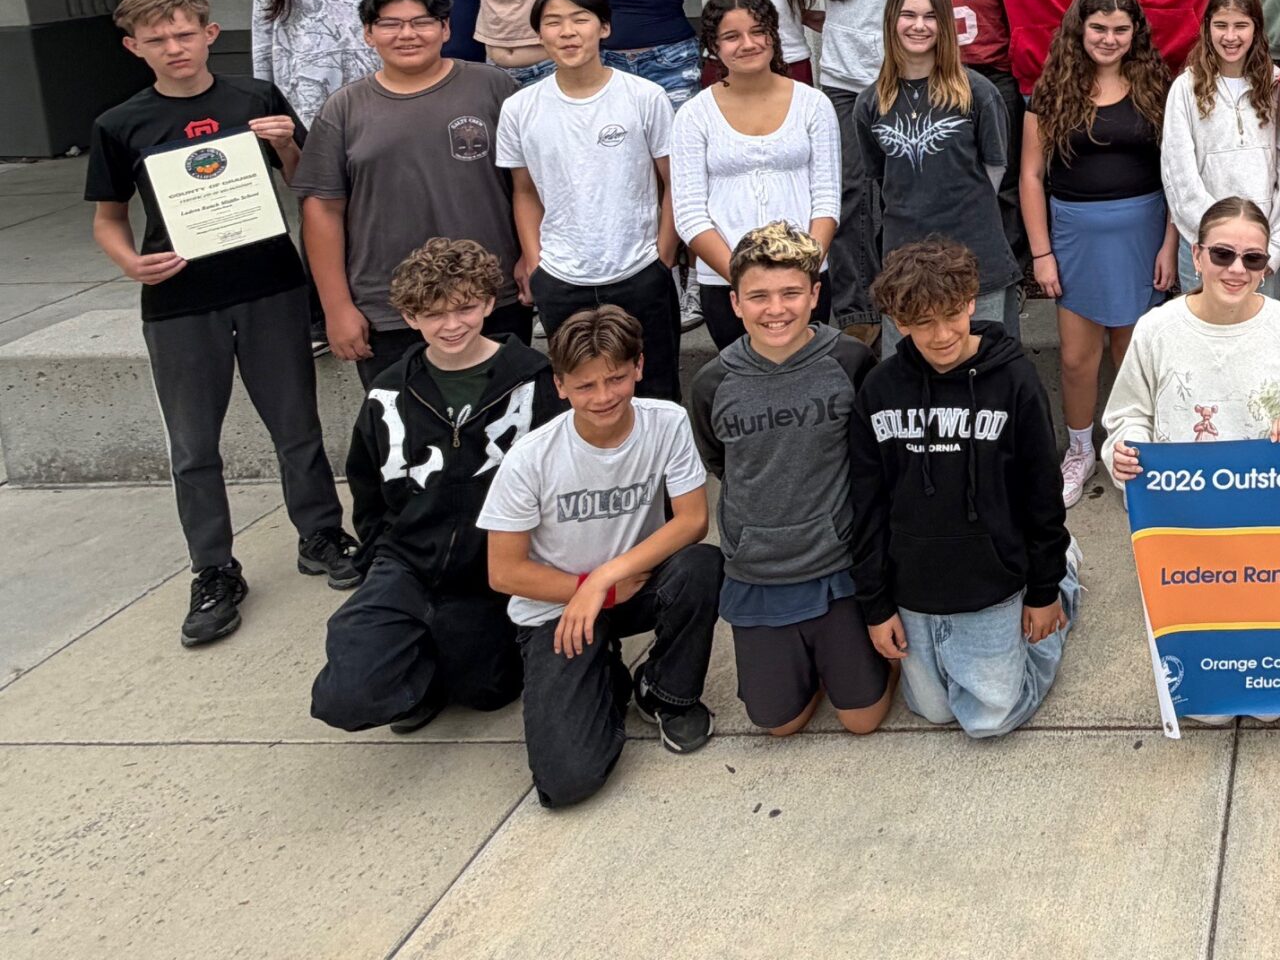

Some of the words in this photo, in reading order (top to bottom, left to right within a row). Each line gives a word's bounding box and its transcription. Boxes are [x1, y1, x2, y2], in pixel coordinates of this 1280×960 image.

[723, 405, 810, 438] Hurley
[906, 442, 961, 453] CALIORNIA
[1146, 469, 1206, 492] 2026
[559, 477, 653, 519] VOLCOM
[1161, 566, 1237, 586] Ladera
[1200, 657, 1257, 672] Orange
